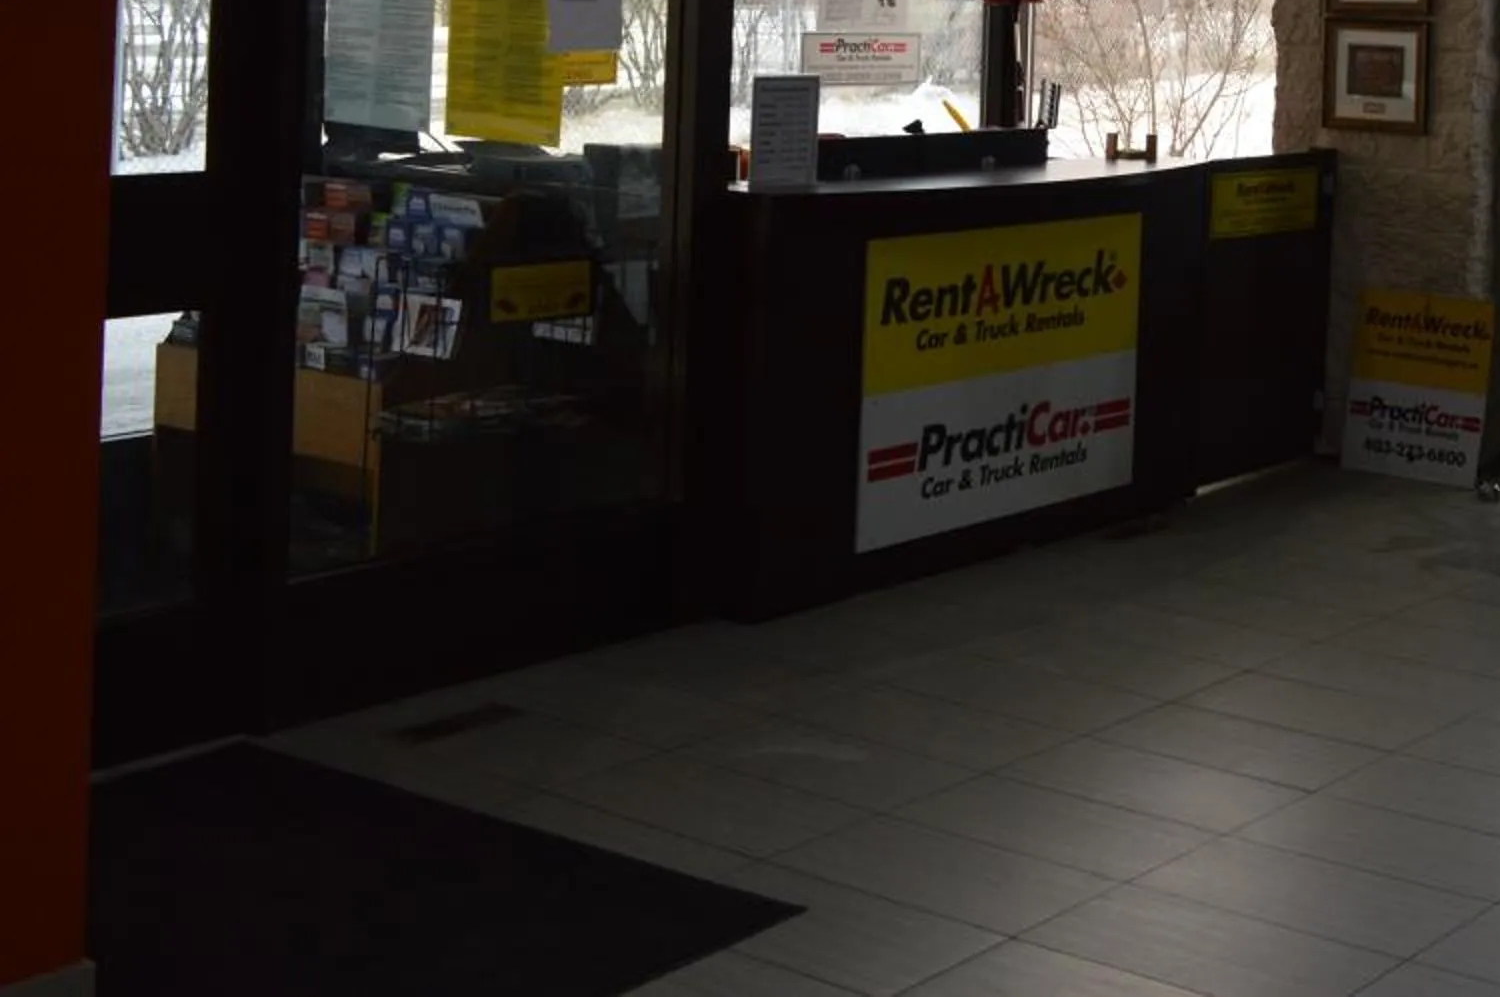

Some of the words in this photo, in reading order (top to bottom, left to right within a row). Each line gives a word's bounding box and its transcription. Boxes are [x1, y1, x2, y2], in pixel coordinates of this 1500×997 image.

[880, 248, 1117, 327] RentAWreck
[915, 328, 948, 351] Car
[953, 323, 968, 345] &
[975, 315, 1019, 343] Truck
[1025, 306, 1085, 333] Rentals
[917, 400, 1082, 472] PractiCar
[1368, 396, 1456, 430] PractiCar
[920, 475, 954, 500] Car
[958, 469, 974, 491] &
[980, 459, 1024, 488] Truck
[1029, 442, 1088, 475] Rentals
